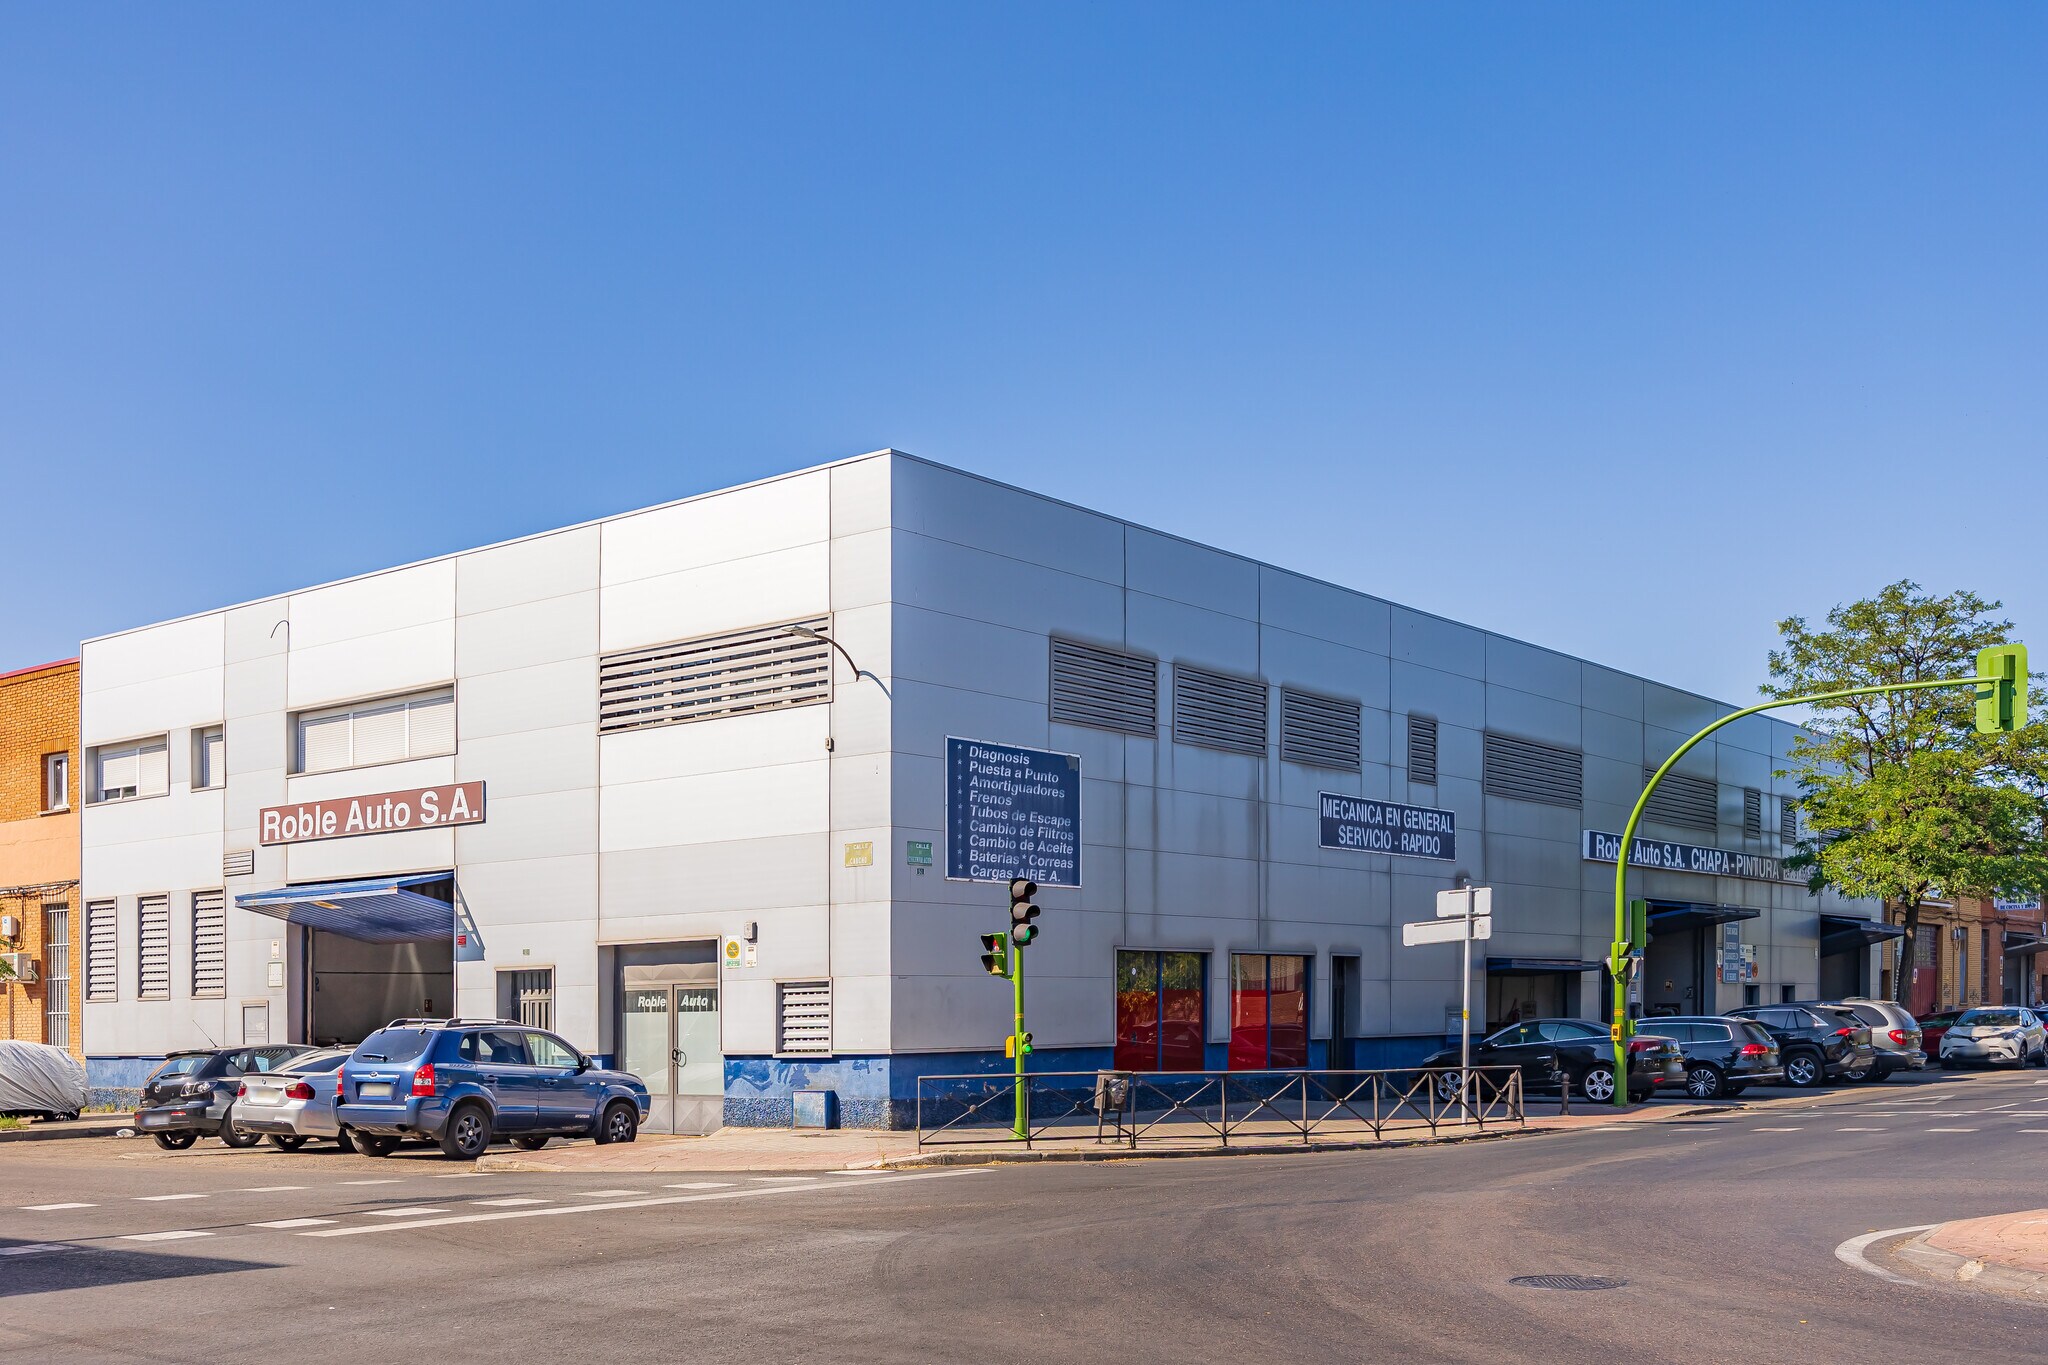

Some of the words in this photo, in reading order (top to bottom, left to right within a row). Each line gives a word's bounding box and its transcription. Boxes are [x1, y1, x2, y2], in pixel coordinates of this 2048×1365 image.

[969, 745, 1030, 765] Diagnosis
[969, 760, 1011, 777] Puesta
[1014, 769, 1022, 779] a
[1025, 768, 1059, 783] Punto
[969, 775, 1065, 798] Amortiguadores
[969, 790, 1012, 806] Frenos
[263, 805, 337, 841] Roble
[345, 798, 411, 832] Auto
[420, 787, 479, 824] S.A.
[970, 804, 1008, 820] Tubos
[1011, 810, 1026, 821] de
[1029, 811, 1071, 828] Escape
[1322, 797, 1383, 825] MECANICA
[1386, 807, 1401, 827] EN
[1403, 809, 1453, 833] GENERAL
[969, 820, 1016, 835] Cambio
[1020, 825, 1035, 837] de
[1037, 826, 1074, 841] Filtros
[1338, 824, 1392, 849] SERVICIO
[1401, 833, 1440, 854] RAPIDO
[969, 834, 1016, 849] Cambio
[1020, 839, 1035, 851] de
[1037, 841, 1073, 855] Aceite
[1596, 834, 1631, 861] Rob
[1634, 840, 1661, 865] Auto
[1663, 844, 1685, 868] S.A.
[969, 849, 1020, 865] Baterias
[1028, 854, 1074, 869] Correas
[970, 864, 1013, 880] Cargas
[1017, 868, 1046, 882] AIRE
[1049, 870, 1061, 882] A.
[637, 995, 667, 1008] Roble
[680, 994, 709, 1007] Auto
